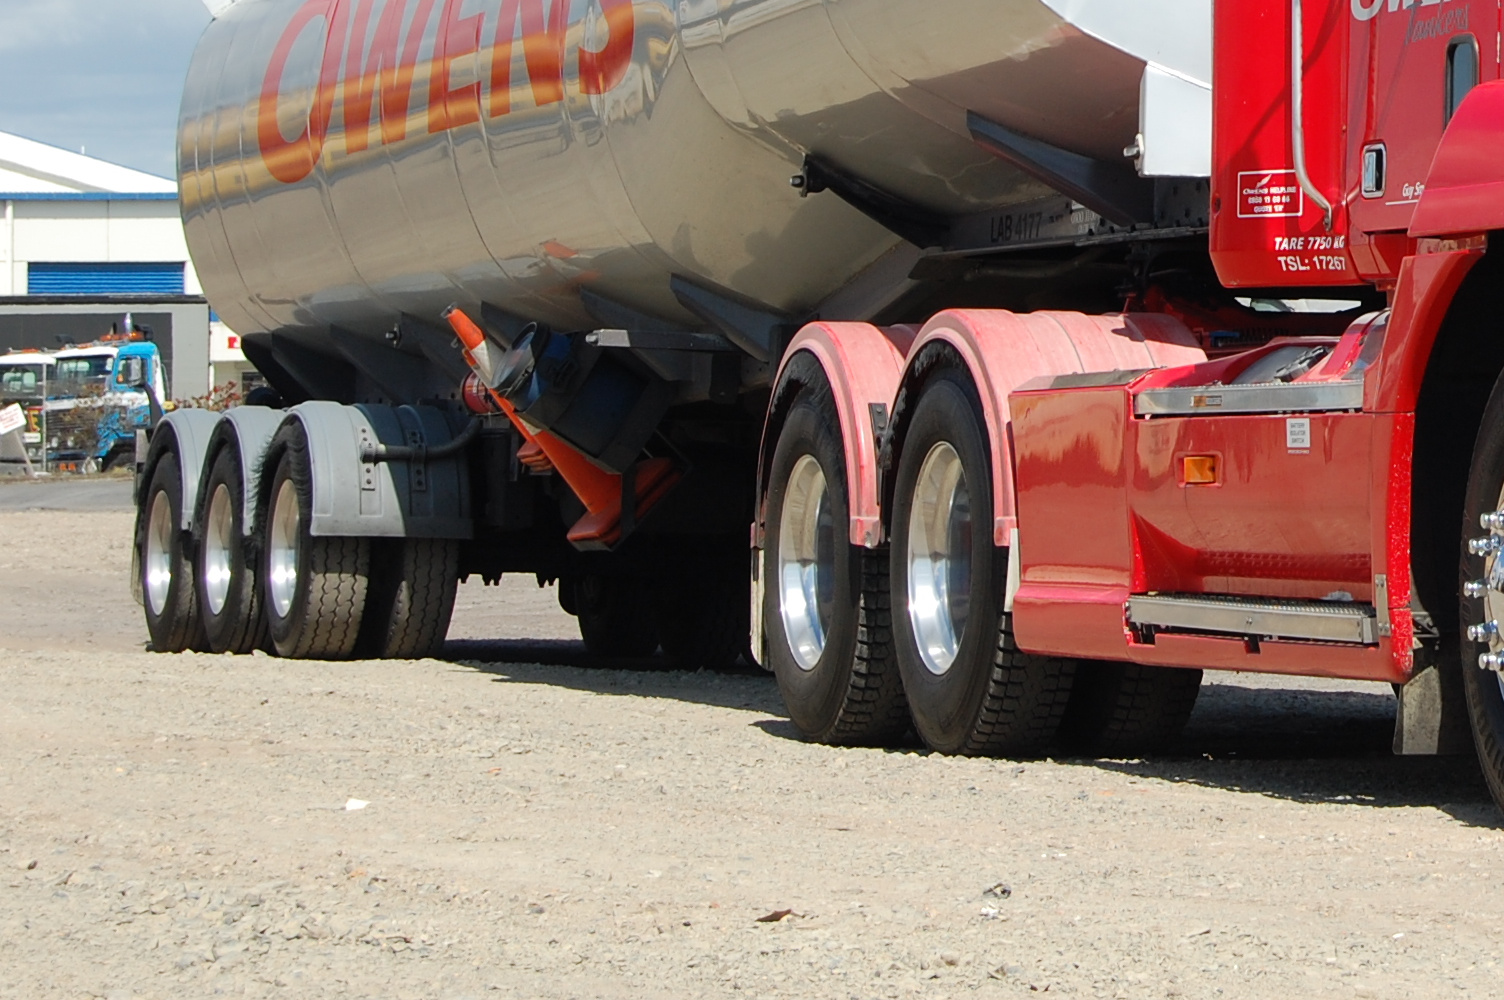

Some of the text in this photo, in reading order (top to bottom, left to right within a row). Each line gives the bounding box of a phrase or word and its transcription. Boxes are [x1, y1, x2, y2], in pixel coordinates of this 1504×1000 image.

[1274, 235, 1345, 251] TARE 7750 KG
[1277, 255, 1346, 272] TSL: 17267
